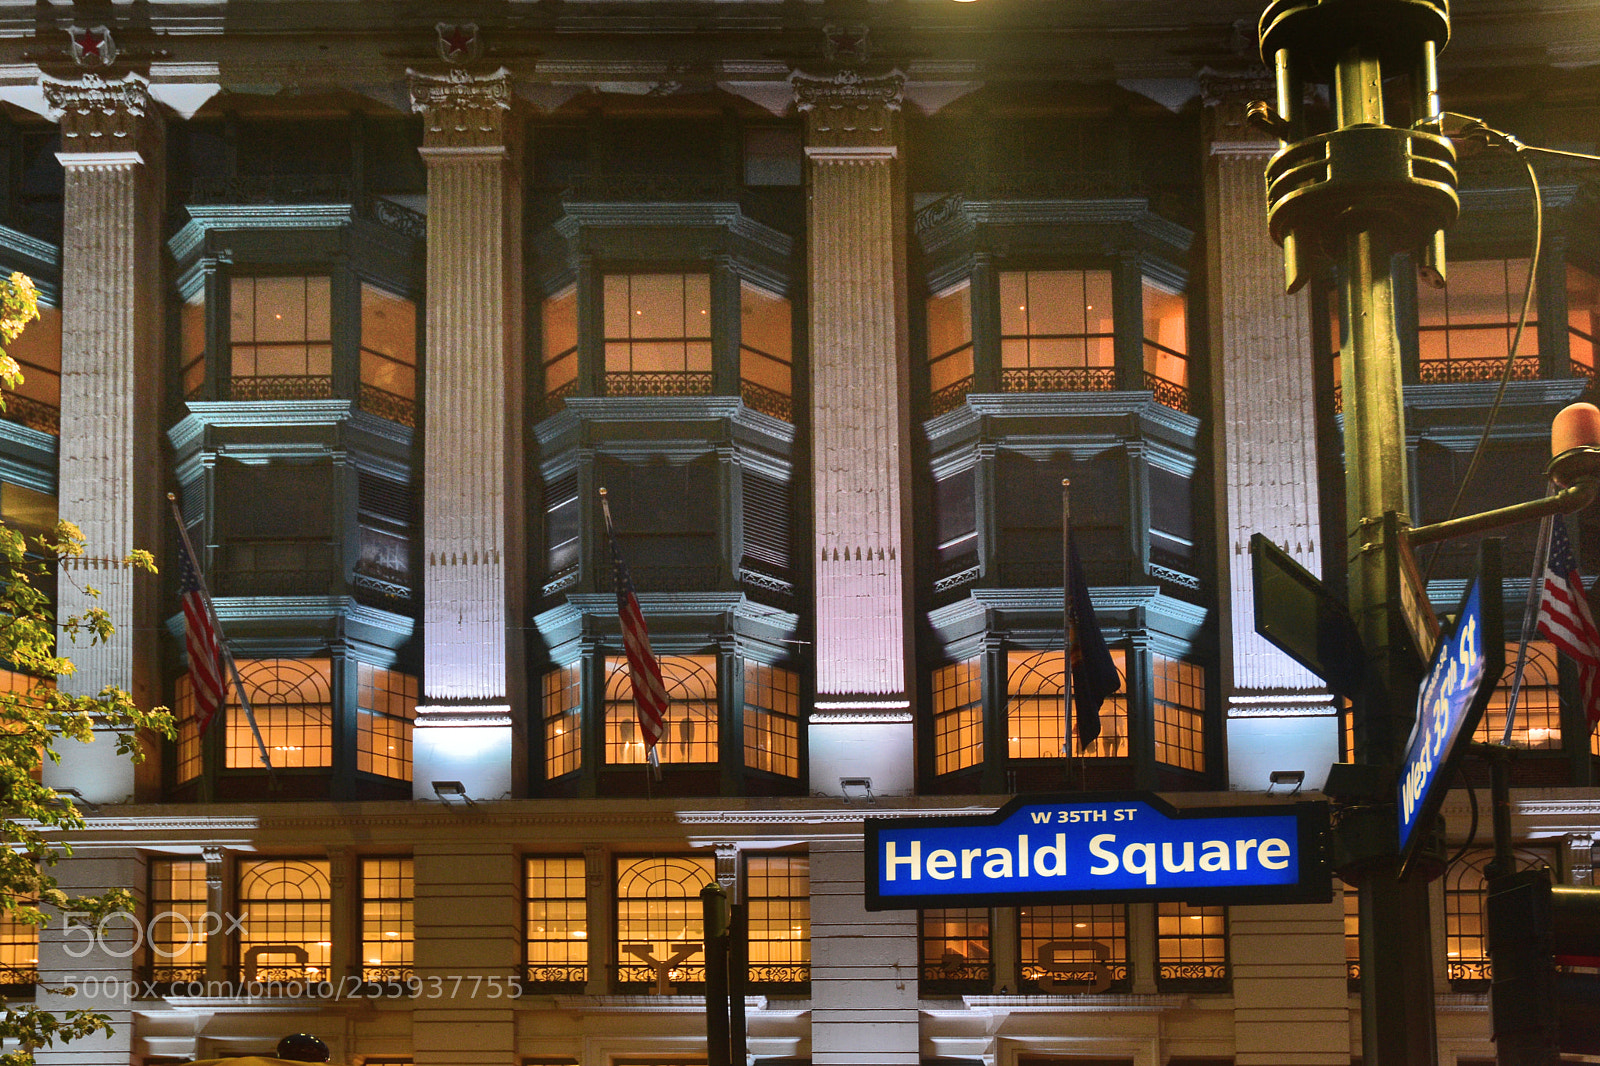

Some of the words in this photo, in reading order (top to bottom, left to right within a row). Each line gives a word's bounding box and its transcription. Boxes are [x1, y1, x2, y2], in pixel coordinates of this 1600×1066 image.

[1402, 727, 1432, 825] West
[1433, 656, 1457, 757] 35th
[1460, 613, 1477, 691] St
[1030, 811, 1052, 825] W
[1057, 809, 1107, 824] 35TH
[1113, 808, 1138, 822] ST
[885, 833, 1067, 881] Herald
[1088, 833, 1292, 885] Square
